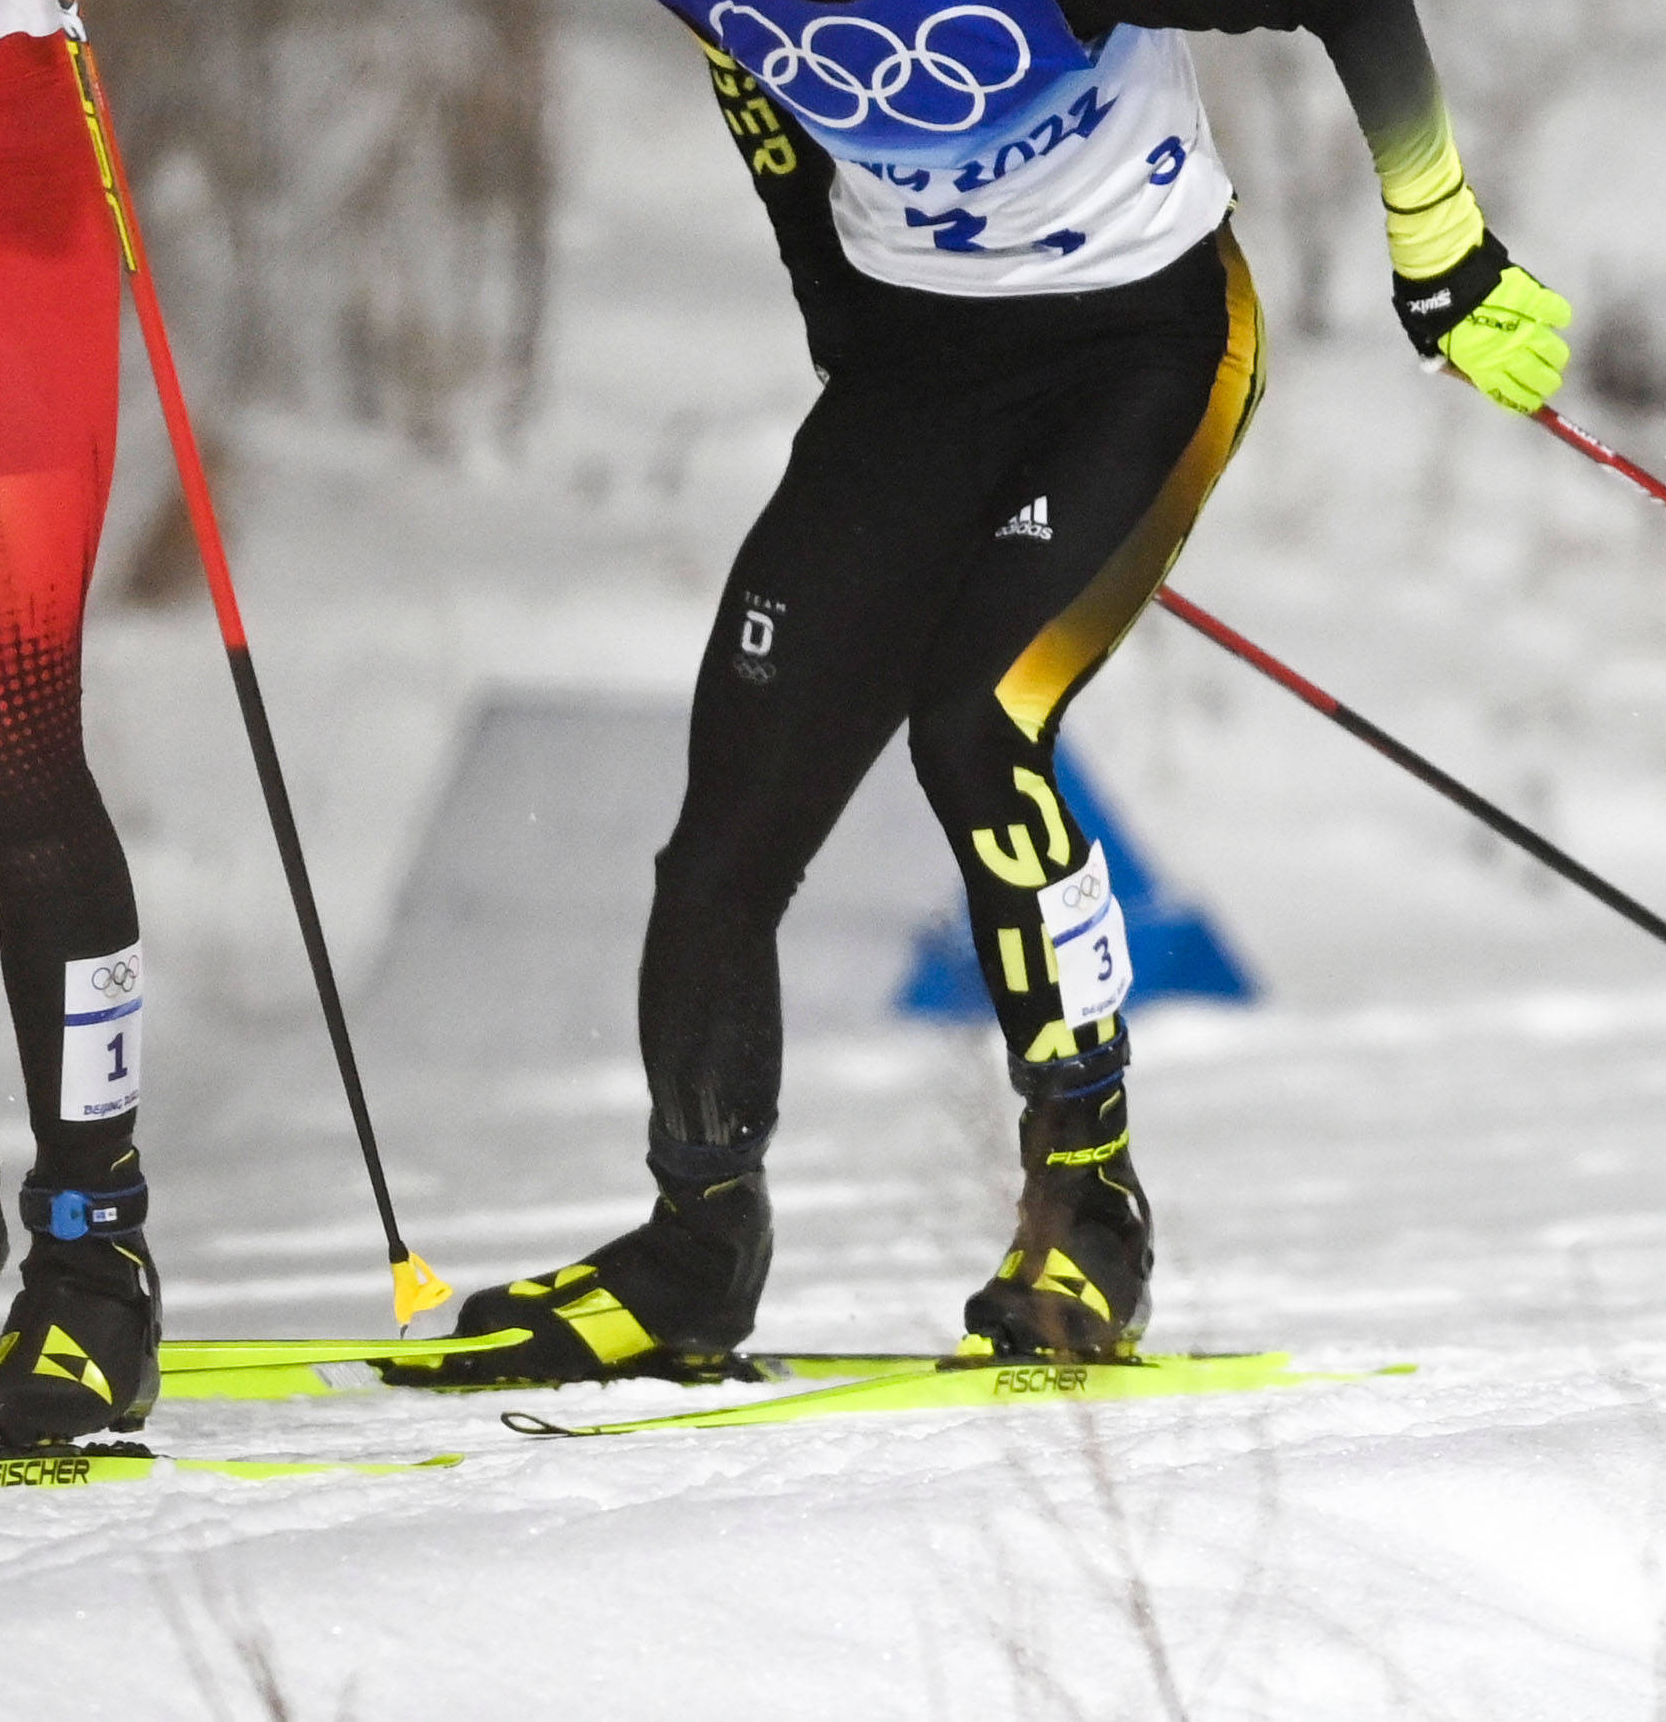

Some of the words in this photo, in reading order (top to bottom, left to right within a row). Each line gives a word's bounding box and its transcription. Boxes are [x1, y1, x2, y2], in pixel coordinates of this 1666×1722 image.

[1092, 935, 1113, 981] 3
[107, 1031, 128, 1082] 1
[993, 1366, 1088, 1396] FISCHER
